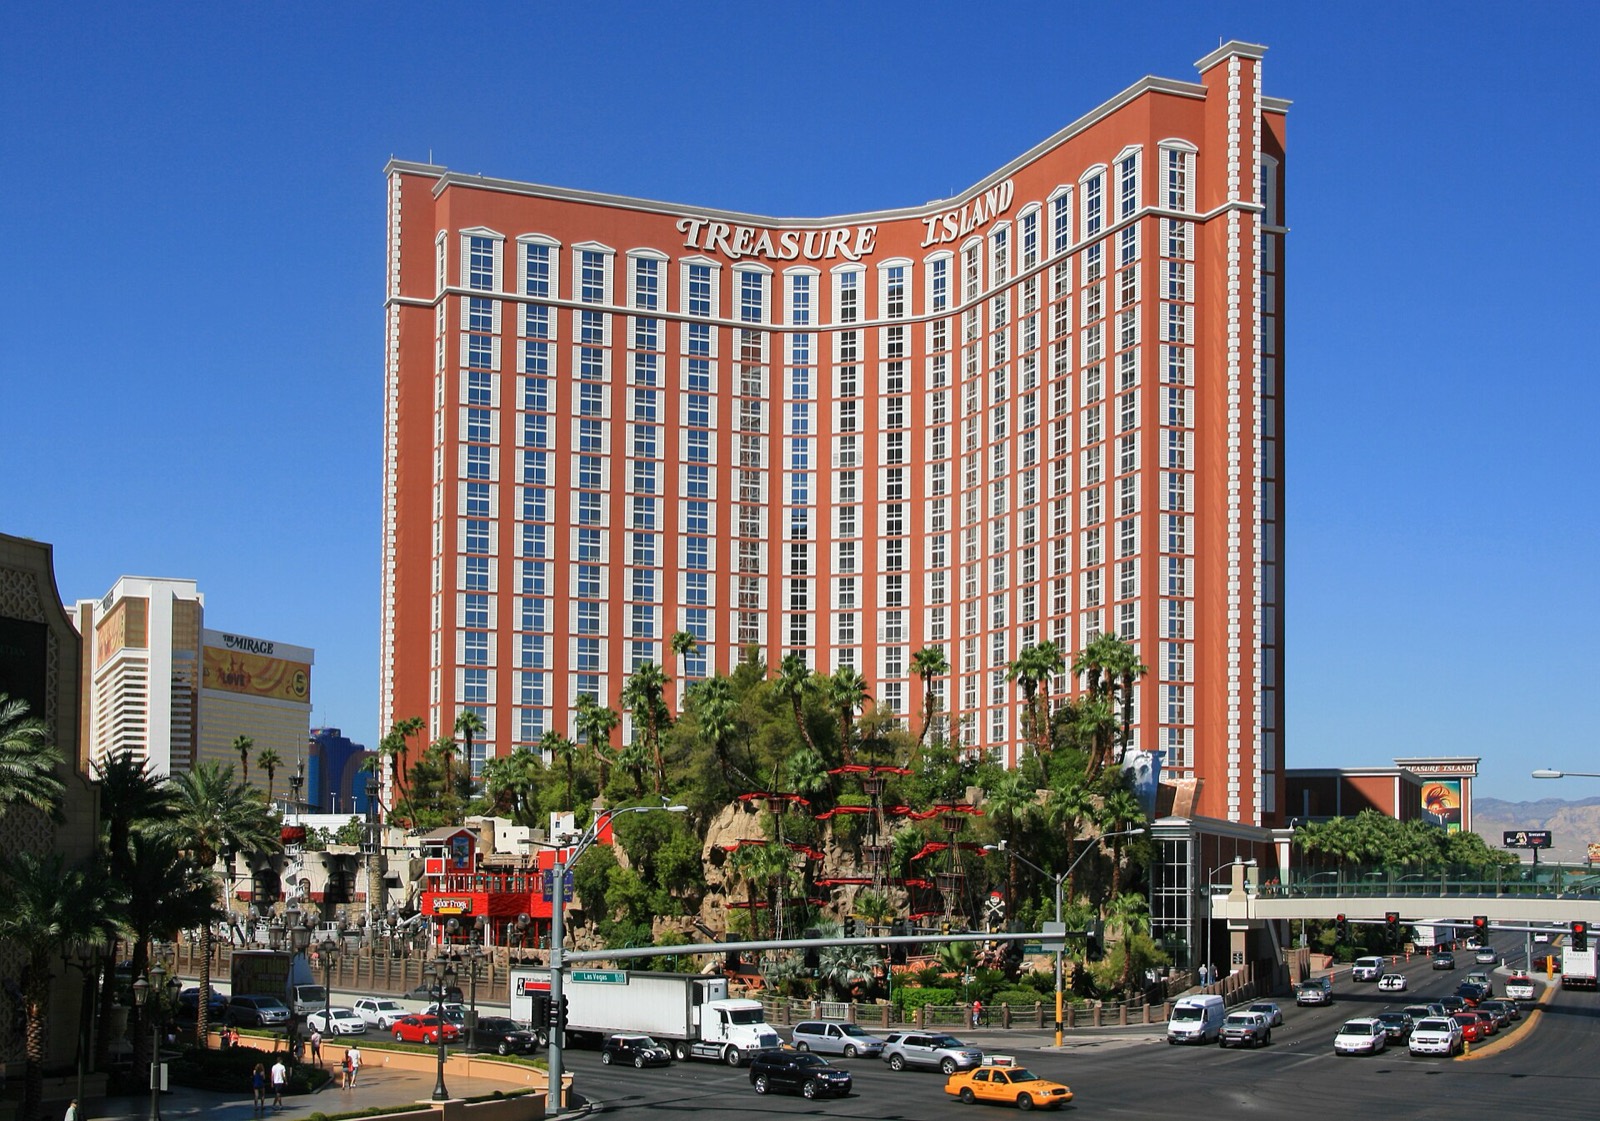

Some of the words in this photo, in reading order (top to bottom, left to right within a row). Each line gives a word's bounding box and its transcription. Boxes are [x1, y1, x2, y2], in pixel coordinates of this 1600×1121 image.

[676, 217, 878, 261] TREASURE
[920, 178, 1015, 248] ISLAND
[223, 634, 234, 643] THE
[226, 637, 274, 655] MIRAGE
[222, 673, 245, 687] LOVE
[593, 973, 608, 982] Vegas
